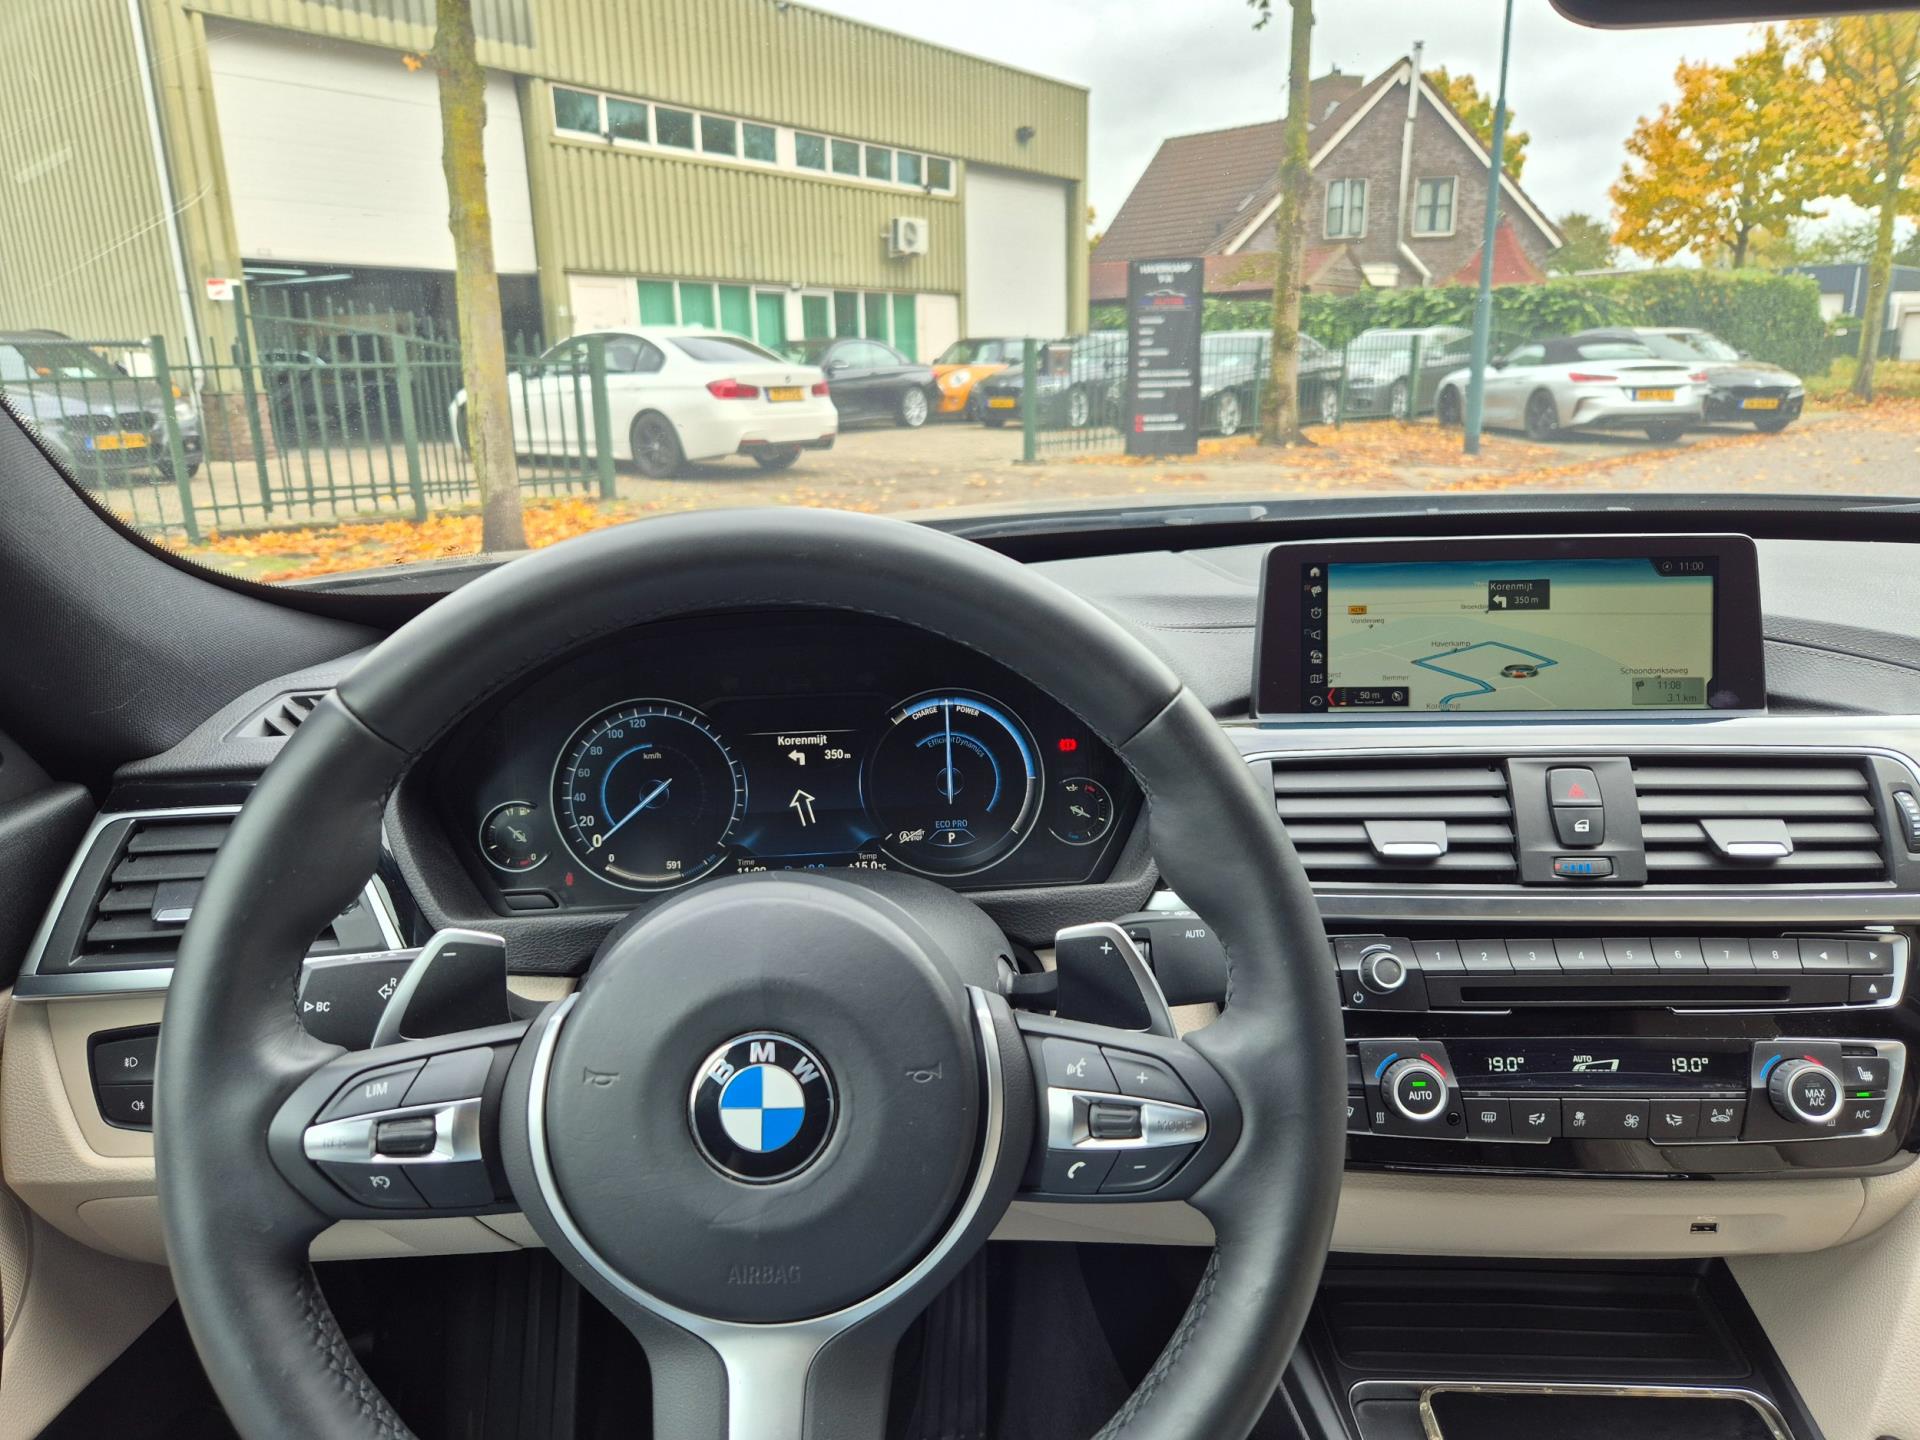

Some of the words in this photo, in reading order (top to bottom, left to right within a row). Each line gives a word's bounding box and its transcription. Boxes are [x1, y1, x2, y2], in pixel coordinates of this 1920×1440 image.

[1679, 562, 1704, 571] 11:00
[1490, 582, 1533, 591] Korenmijt
[1514, 596, 1529, 604] 350
[1431, 640, 1471, 648] Haverkamp
[1620, 666, 1689, 675] Schoondonkseweg
[1359, 692, 1371, 700] 50
[1683, 693, 1697, 703] km
[911, 706, 939, 720] CHARGE
[956, 705, 980, 717] POWER
[629, 719, 646, 728] 120
[607, 730, 624, 738] 100
[777, 734, 828, 747] Korenmijt
[590, 747, 603, 755] 80
[824, 749, 844, 760] 350
[643, 752, 662, 760] km/h
[577, 769, 591, 777] 60
[574, 793, 586, 801] 40
[579, 816, 595, 827] 20
[935, 819, 950, 828] ECO
[953, 819, 968, 828] PRO
[592, 833, 602, 848] 0
[948, 833, 956, 844] P
[531, 853, 537, 861] 0
[608, 854, 615, 862] 0
[858, 853, 878, 861] Temp
[666, 861, 682, 870] 591
[738, 858, 755, 866] Time
[1185, 929, 1206, 939] AUTO
[1435, 952, 1441, 961] 1
[1481, 952, 1488, 961] 2
[1529, 952, 1536, 961] 3
[1578, 952, 1585, 961] 4
[1626, 951, 1633, 960] 5
[1674, 951, 1682, 960] 6
[1723, 951, 1730, 960] 7
[1772, 951, 1779, 960] 8
[390, 978, 397, 987] R
[315, 1002, 330, 1012] BC
[708, 1041, 820, 1086] BMW
[1572, 1055, 1593, 1063] AUTO
[1488, 1056, 1525, 1072] 19.0°
[1671, 1056, 1709, 1072] 19.0°
[365, 1082, 388, 1098] LIM
[1805, 1089, 1826, 1098] MAX
[1408, 1090, 1433, 1101] AUTO
[1809, 1098, 1826, 1107] A/C
[1711, 1108, 1719, 1116] A
[1726, 1108, 1734, 1116] M
[1855, 1110, 1871, 1119] A/C
[1573, 1119, 1586, 1127] OFF
[728, 1265, 801, 1285] AIRBAG
